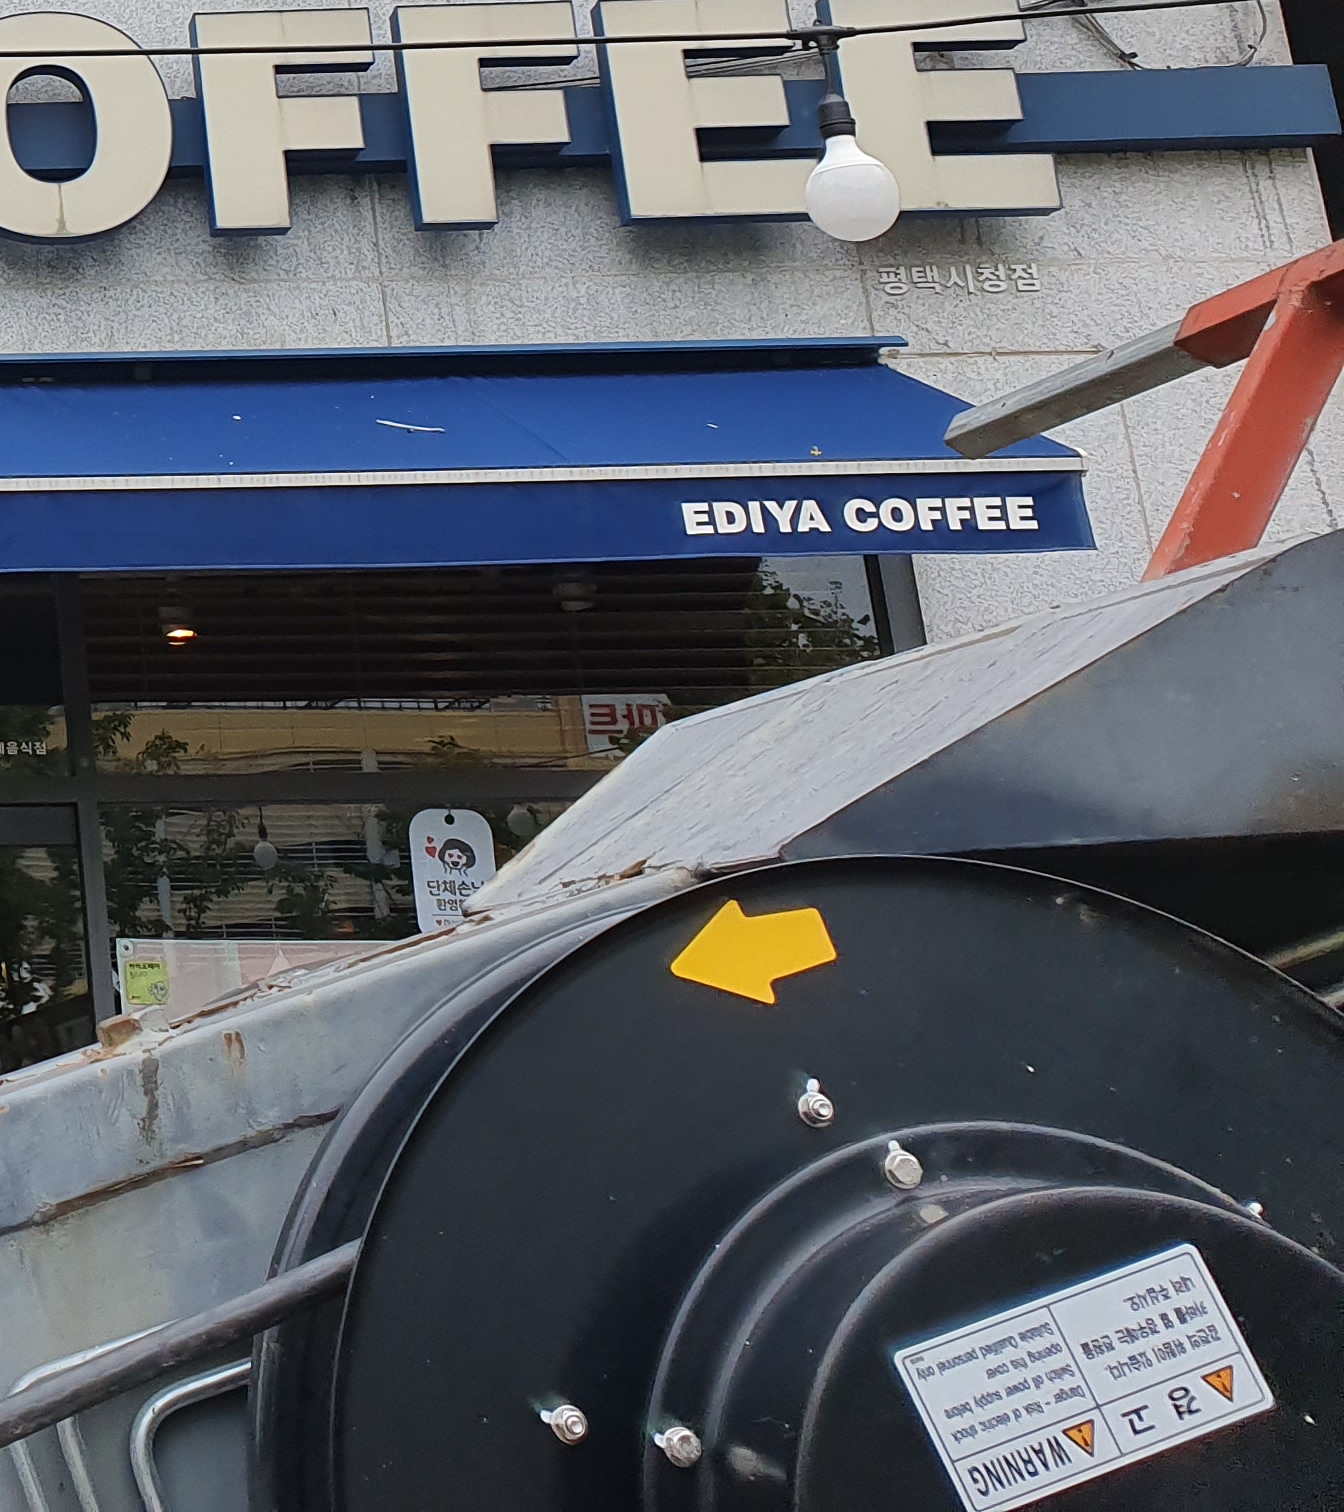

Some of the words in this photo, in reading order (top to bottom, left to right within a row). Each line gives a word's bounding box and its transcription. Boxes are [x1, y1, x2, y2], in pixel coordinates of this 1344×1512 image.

[878, 263, 1041, 295] 평택시청점
[681, 499, 832, 535] EDIYA
[843, 496, 1039, 532] COFFEE
[1027, 1343, 1063, 1363] opening
[986, 1363, 1009, 1379] cover
[1004, 1377, 1031, 1397] power
[1053, 1385, 1086, 1404] Danger
[944, 1402, 974, 1419] before
[973, 1391, 1003, 1411] supply
[1120, 1386, 1202, 1436] 경고
[970, 1434, 1072, 1495] WARNING
